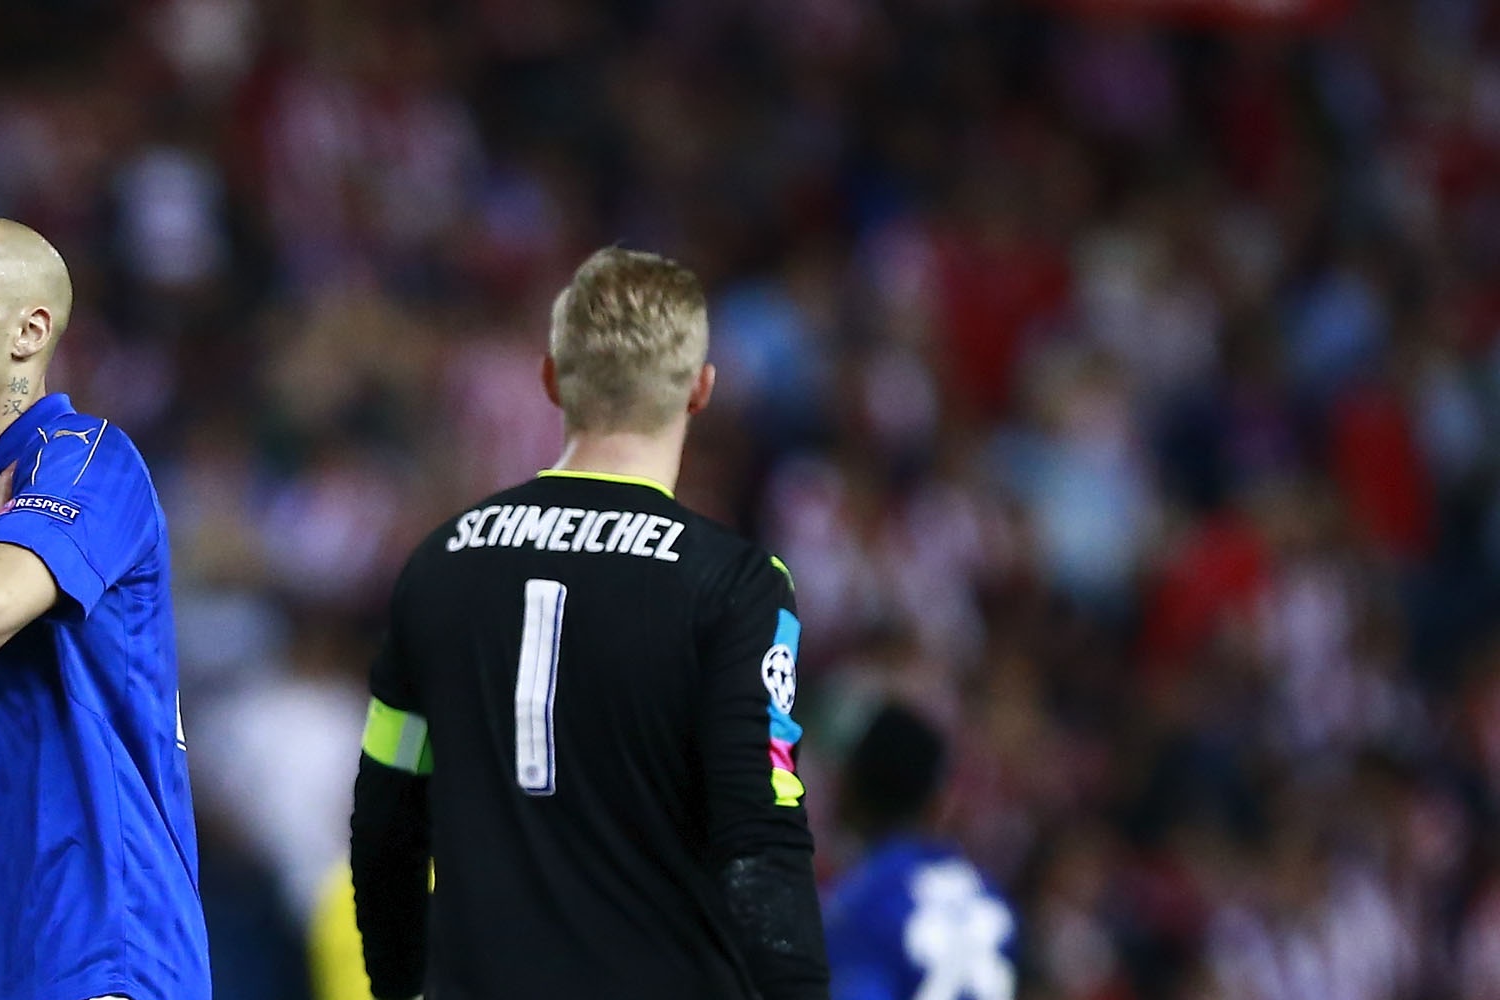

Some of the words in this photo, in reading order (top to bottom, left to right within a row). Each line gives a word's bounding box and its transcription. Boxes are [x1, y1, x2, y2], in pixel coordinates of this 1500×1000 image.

[15, 498, 80, 519] RESPECT
[447, 505, 685, 562] SCHMEICHEL
[514, 577, 568, 796] 1
